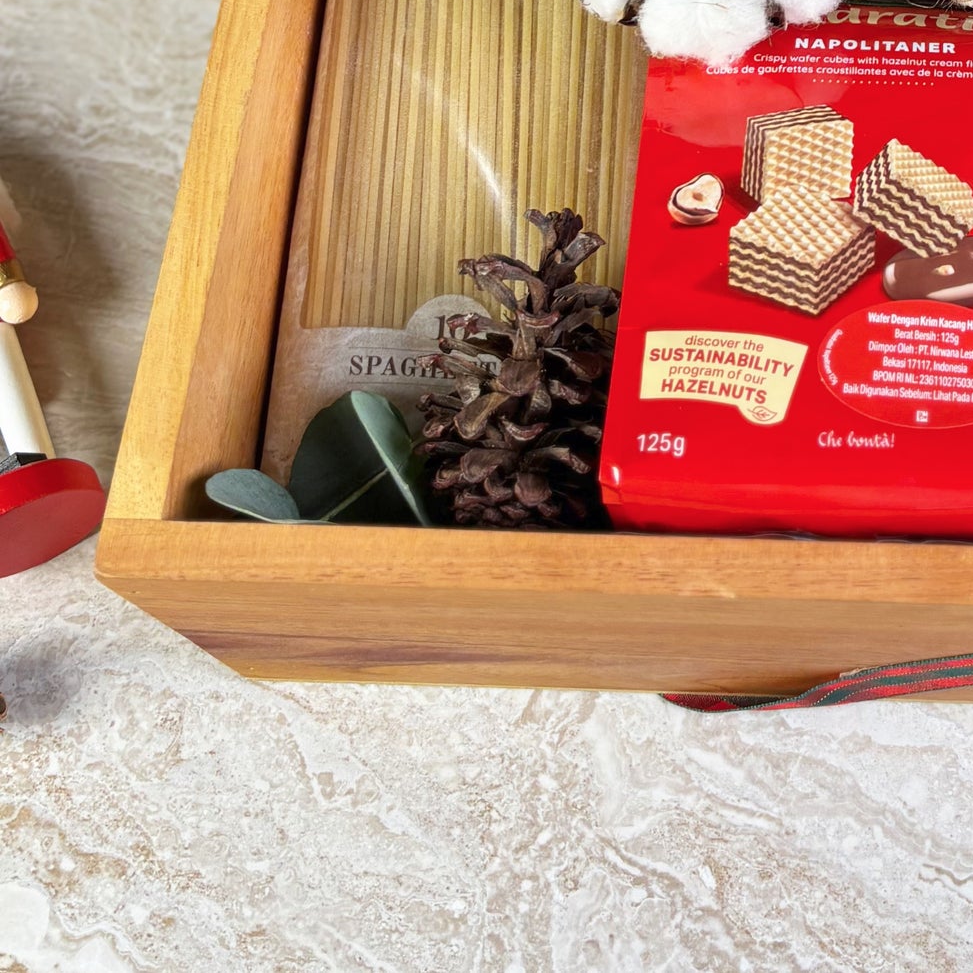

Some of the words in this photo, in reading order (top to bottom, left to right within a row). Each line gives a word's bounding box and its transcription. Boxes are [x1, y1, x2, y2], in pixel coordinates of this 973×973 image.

[794, 37, 956, 54] NAPOLITANER
[753, 53, 787, 63] Crispy
[790, 53, 822, 63] wafer
[823, 55, 855, 64] cubes
[857, 56, 879, 65] with
[882, 57, 927, 67] hazelnut
[929, 58, 963, 67] cream
[741, 64, 755, 74] de
[757, 64, 814, 75] gaufrettes
[815, 65, 887, 76] croustillantes
[889, 69, 915, 77] avec
[917, 68, 931, 78] de
[867, 312, 891, 324] Wafer
[891, 314, 919, 326] Dengan
[919, 316, 938, 326] Krim
[939, 318, 966, 332] Kacang
[685, 334, 741, 349] discover
[743, 339, 764, 352] the
[895, 328, 914, 339] Berat
[914, 329, 936, 341] Bersih
[940, 331, 960, 345] 125g
[868, 341, 896, 353] Diimpor
[930, 346, 960, 359] Nirwana
[650, 347, 794, 377] SUSTAINABILITY
[882, 356, 907, 368] Bekasi
[933, 361, 968, 374] Indonesia
[669, 365, 725, 378] program
[727, 369, 742, 380] of
[744, 373, 767, 385] our
[873, 370, 896, 382] BPOM
[661, 378, 768, 404] HAZELNUTS
[860, 384, 899, 397] Digunakan
[951, 391, 971, 402] Pada
[636, 432, 686, 457] 125g
[818, 430, 843, 448] Che
[846, 431, 895, 448] bontà!
